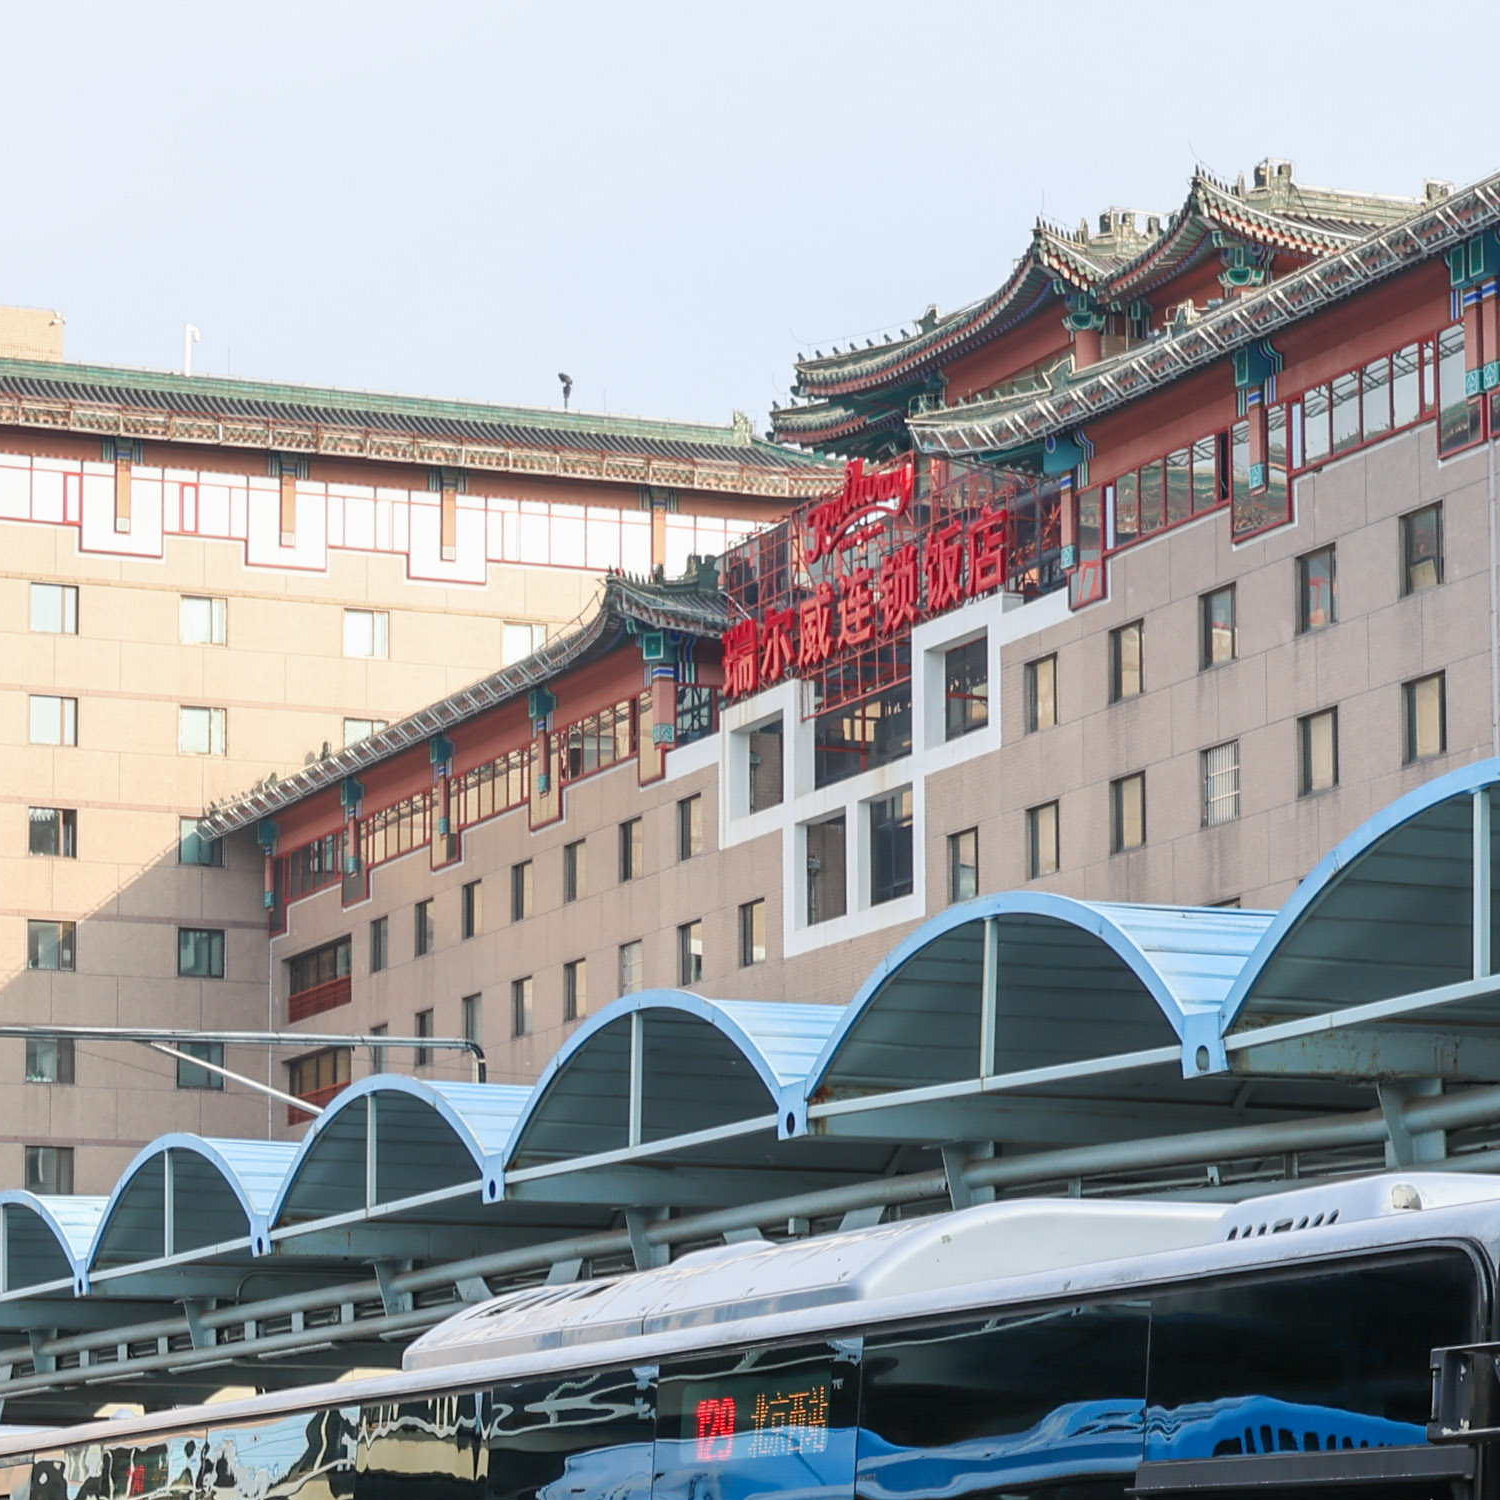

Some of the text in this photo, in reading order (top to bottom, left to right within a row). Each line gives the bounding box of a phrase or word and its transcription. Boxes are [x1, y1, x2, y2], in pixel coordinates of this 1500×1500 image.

[722, 503, 1008, 698] 瑞尔威连锁饭店
[696, 1384, 829, 1461] 129 北京西站
